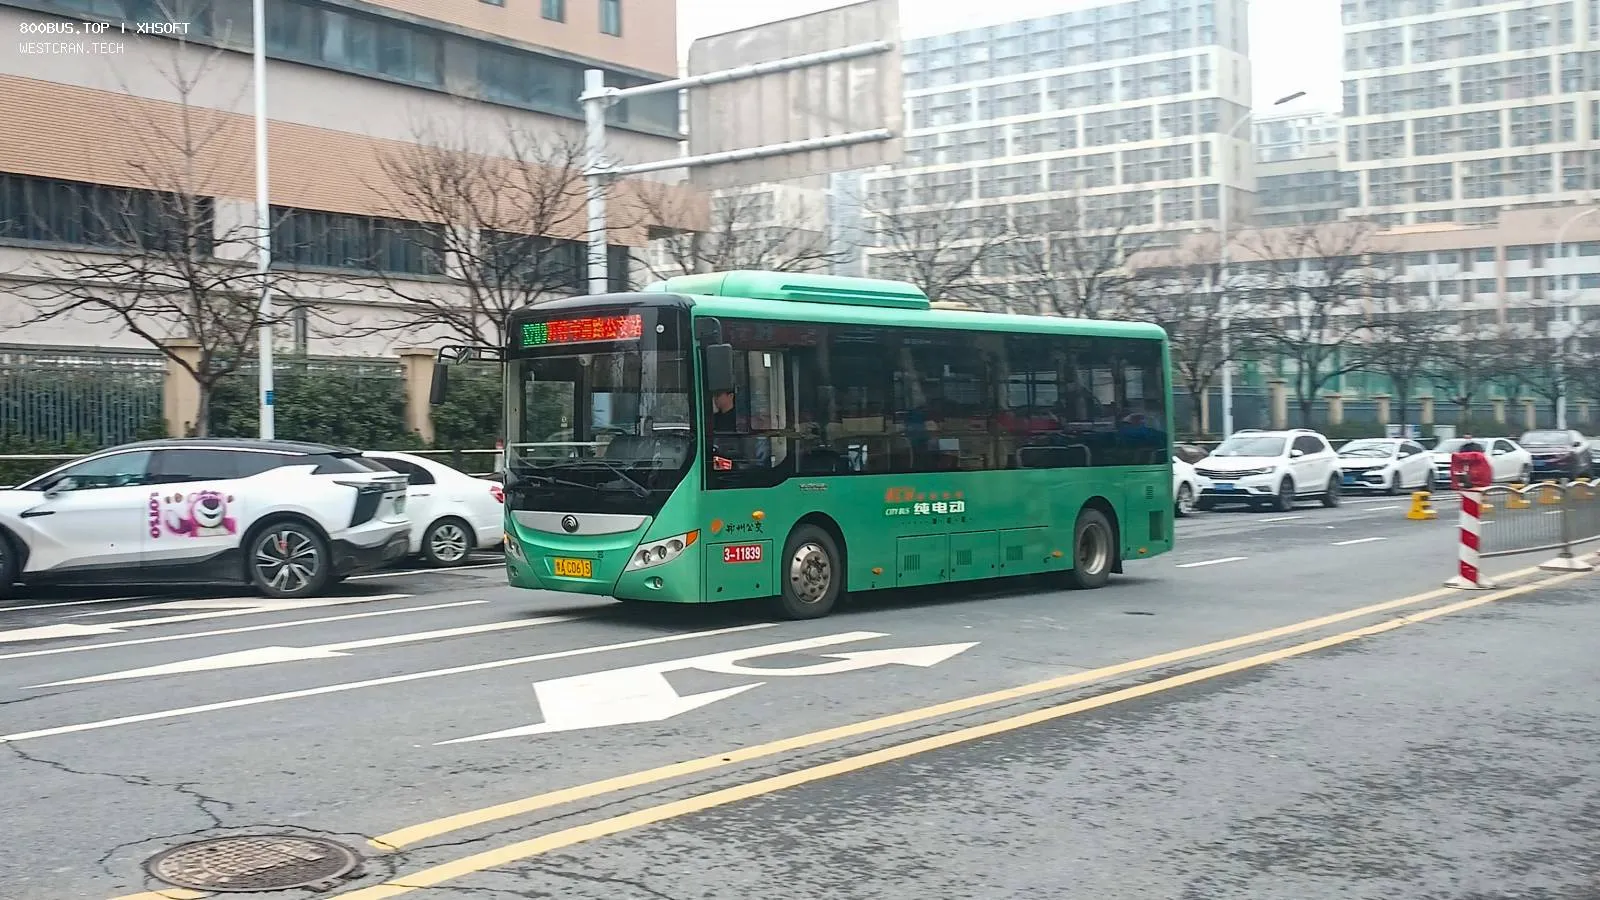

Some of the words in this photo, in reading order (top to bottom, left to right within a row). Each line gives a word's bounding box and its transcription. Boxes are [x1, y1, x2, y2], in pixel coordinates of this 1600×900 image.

[913, 500, 965, 515] 纯电动
[724, 546, 761, 561] 3-11839
